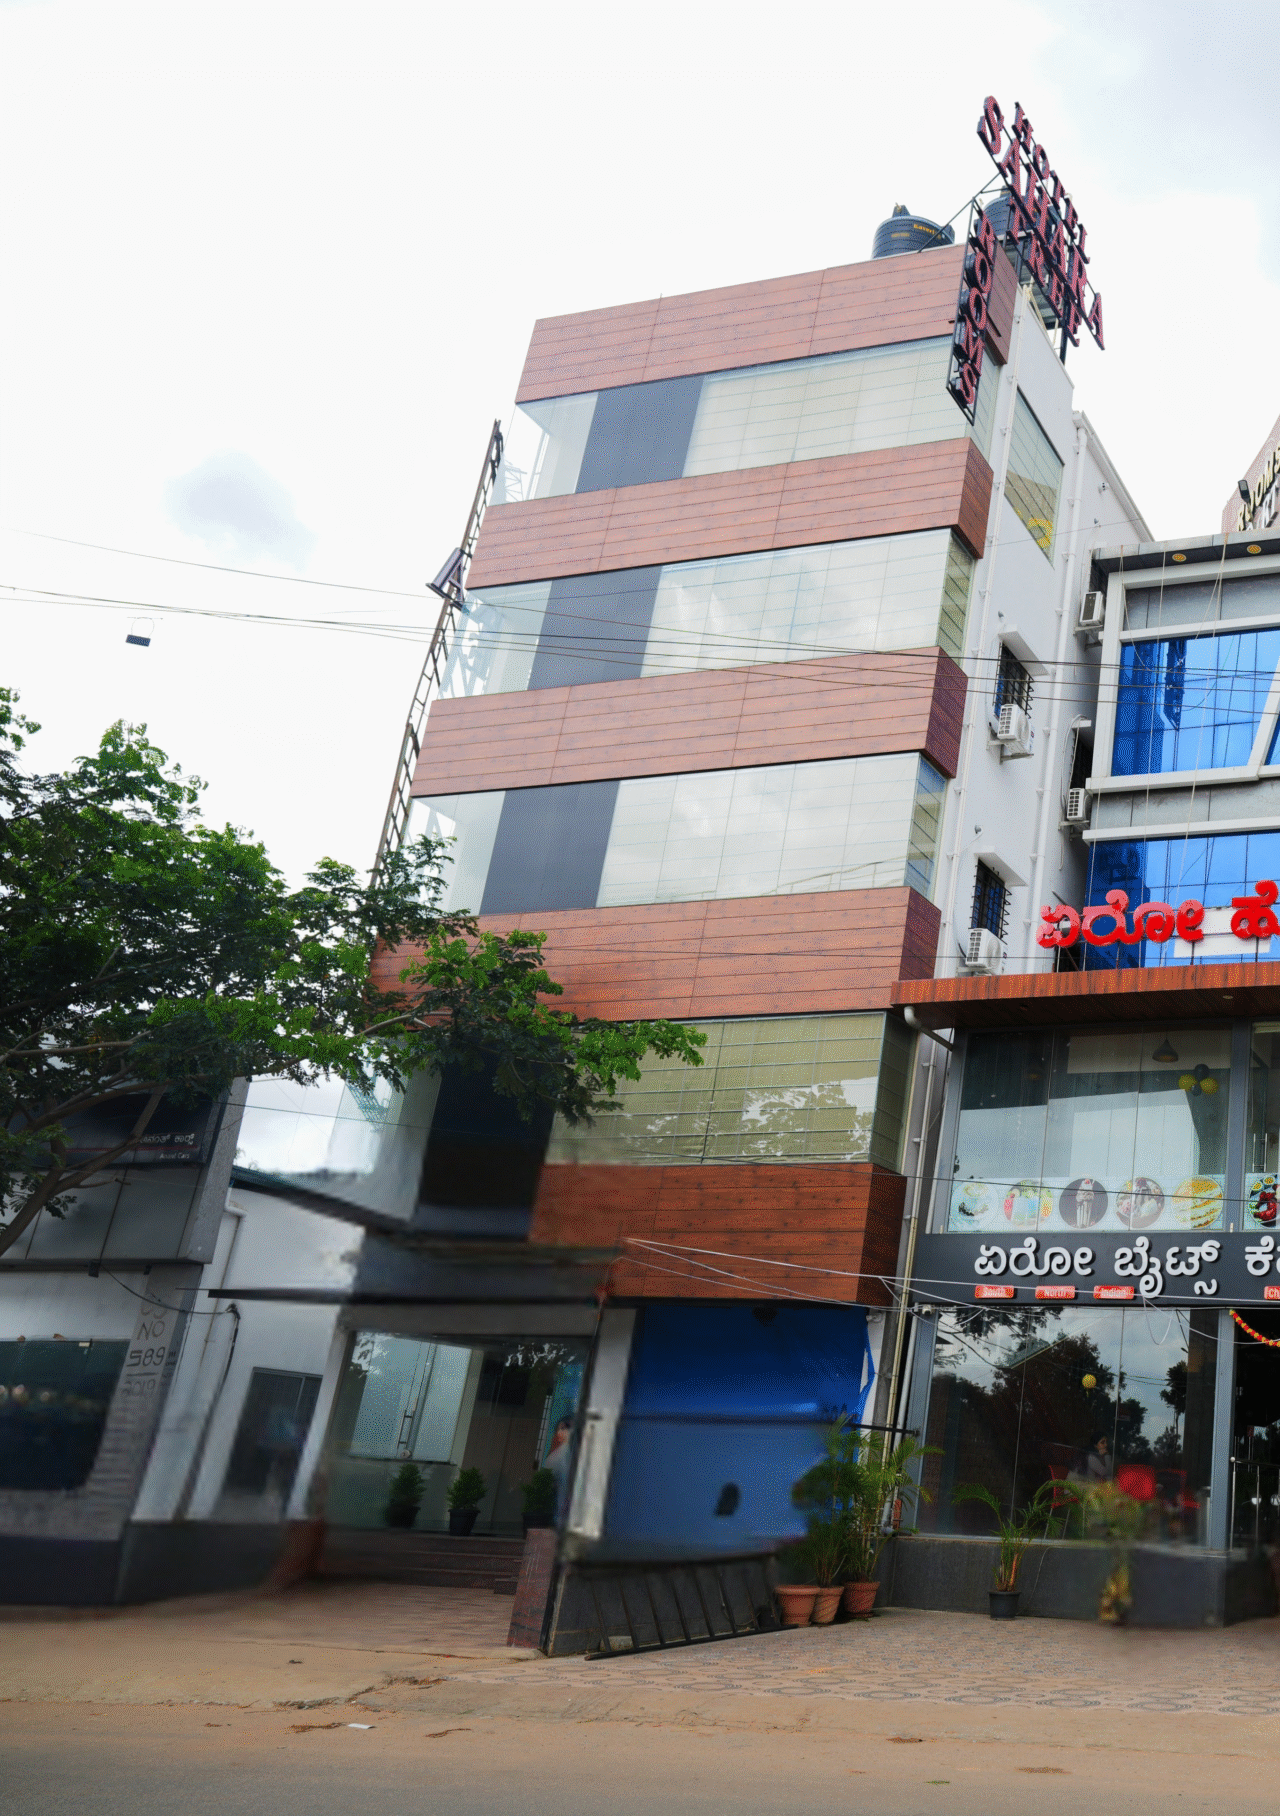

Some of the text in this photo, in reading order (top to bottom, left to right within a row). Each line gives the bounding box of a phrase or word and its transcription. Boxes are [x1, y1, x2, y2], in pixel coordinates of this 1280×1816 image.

[1011, 101, 1091, 264] HOTEL
[976, 96, 1105, 351] SAHARA
[957, 200, 998, 406] ROOMS
[1036, 888, 1205, 949] ಏರೋ
[974, 1237, 1096, 1277] ಏರೋ
[126, 1346, 166, 1367] 589
[136, 1320, 165, 1340] NO
